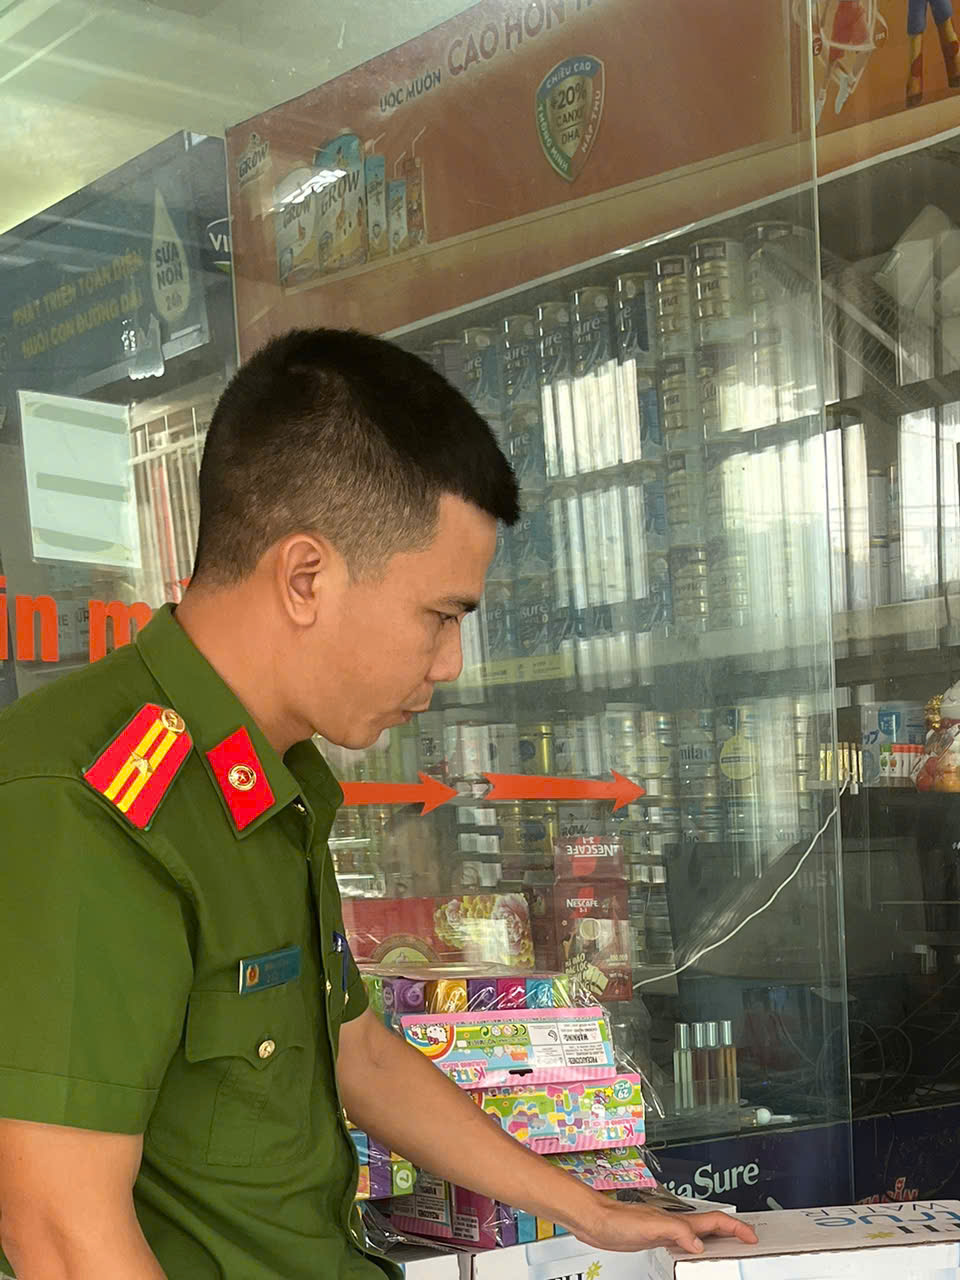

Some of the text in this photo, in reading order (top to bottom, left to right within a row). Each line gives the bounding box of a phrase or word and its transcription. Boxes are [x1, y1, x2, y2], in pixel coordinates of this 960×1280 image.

[448, 24, 499, 76] CAO
[561, 130, 580, 145] DHA
[156, 264, 184, 290] NON
[664, 1160, 760, 1200] iaSure
